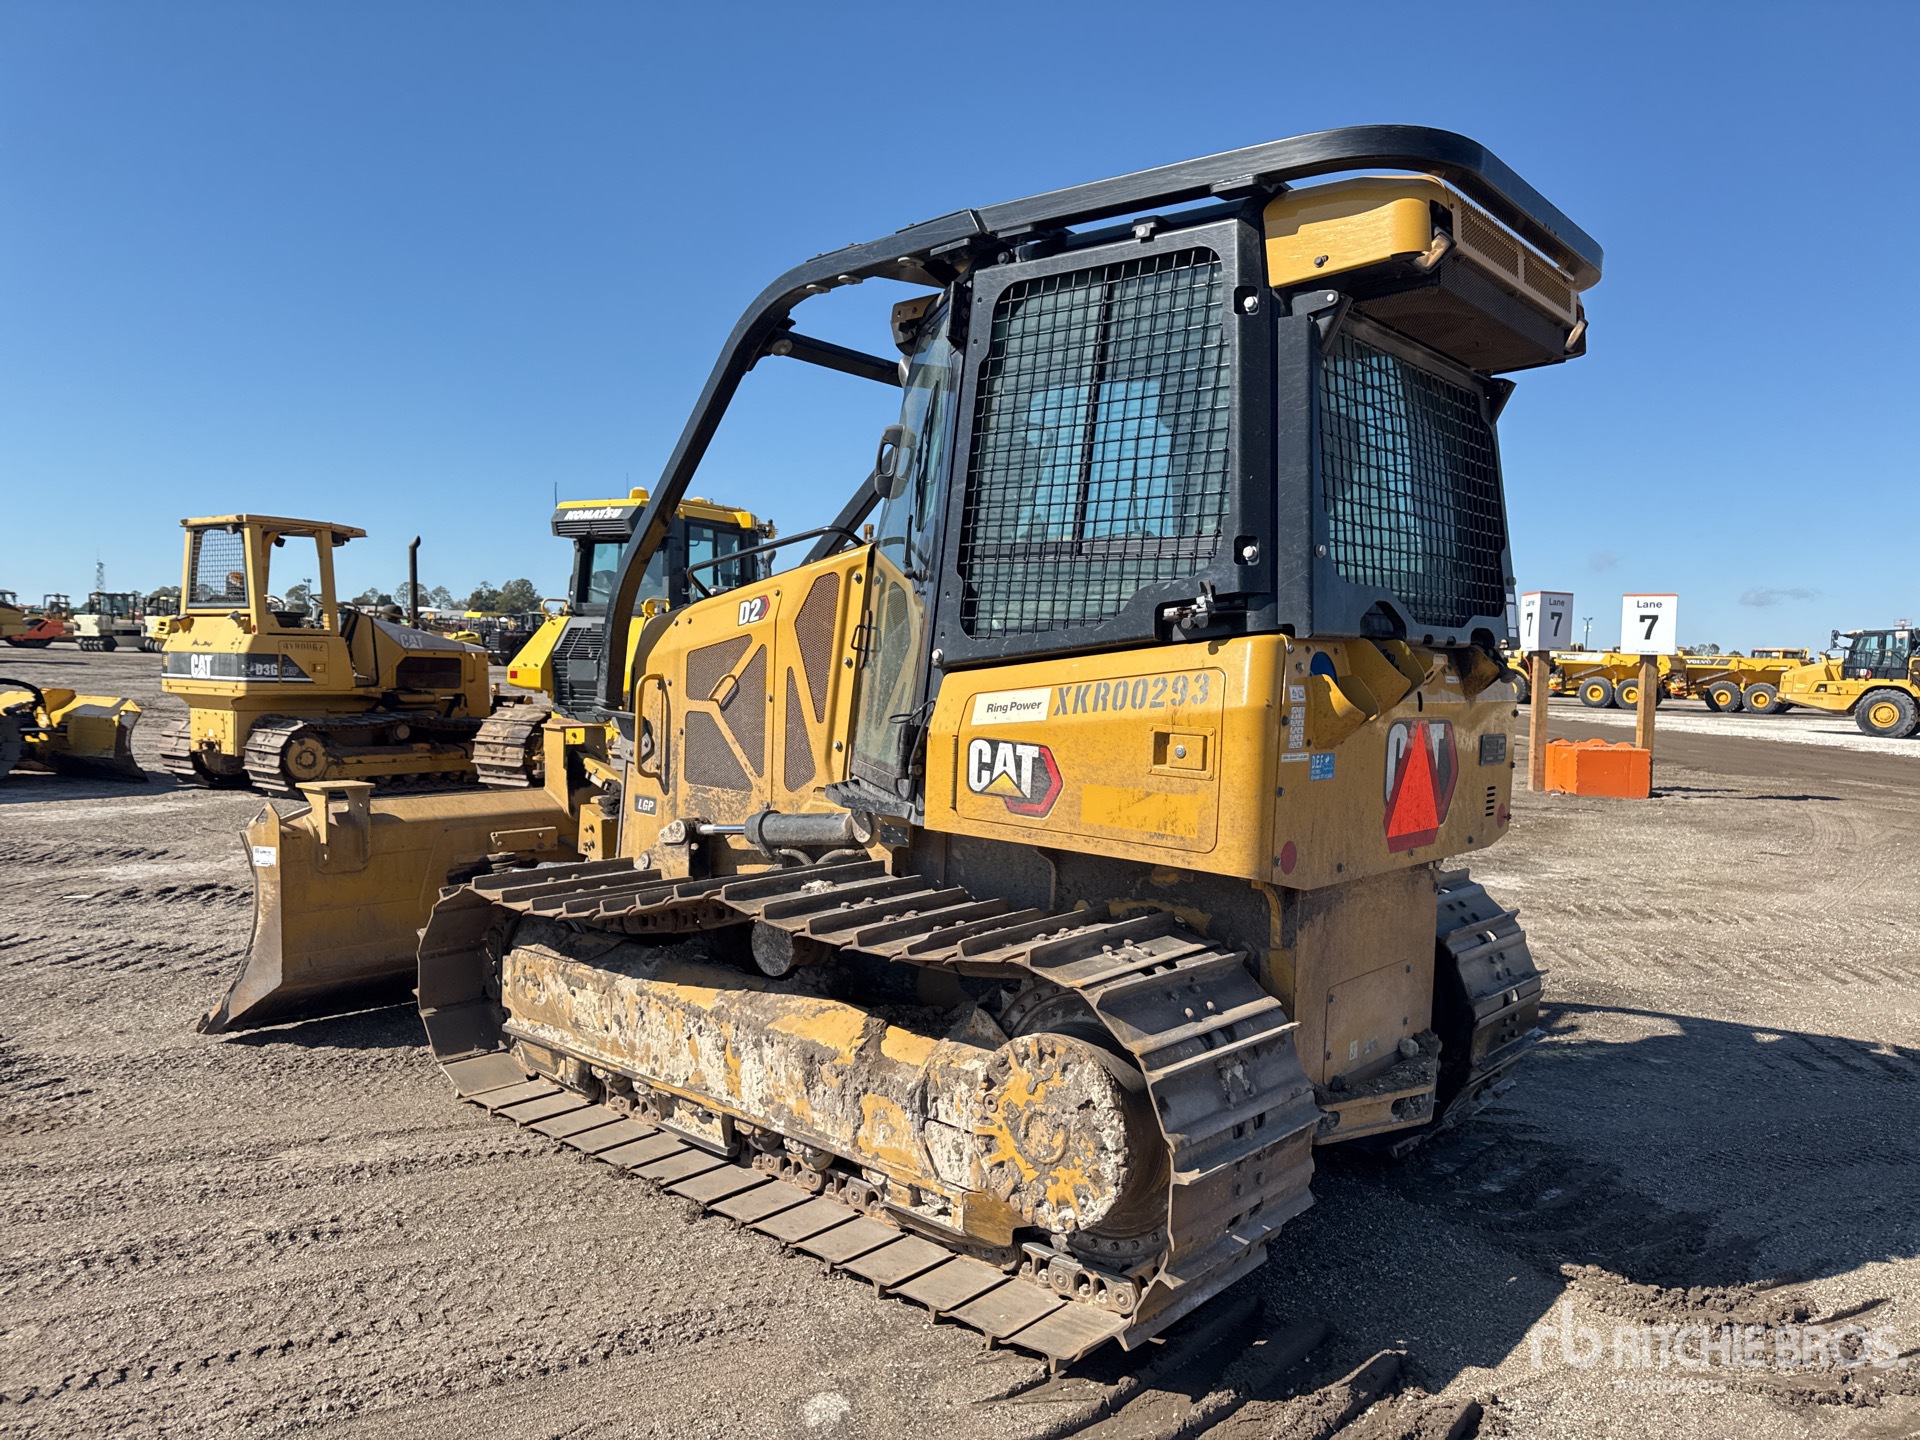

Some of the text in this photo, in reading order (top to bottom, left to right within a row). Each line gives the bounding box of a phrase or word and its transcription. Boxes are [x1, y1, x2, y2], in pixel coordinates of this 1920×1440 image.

[564, 507, 623, 520] KOMATSU
[738, 598, 762, 626] D2
[1549, 597, 1565, 606] Lane
[1637, 600, 1662, 608] Lane
[1526, 612, 1533, 637] 7
[1550, 611, 1562, 637] 7
[1639, 614, 1659, 640] 7
[190, 653, 213, 679] CAT
[255, 663, 278, 676] D3G
[1053, 673, 1210, 716] XKR00293
[986, 701, 1042, 714] Ring Power
[968, 739, 1040, 799] CAT
[637, 798, 654, 811] LGP
